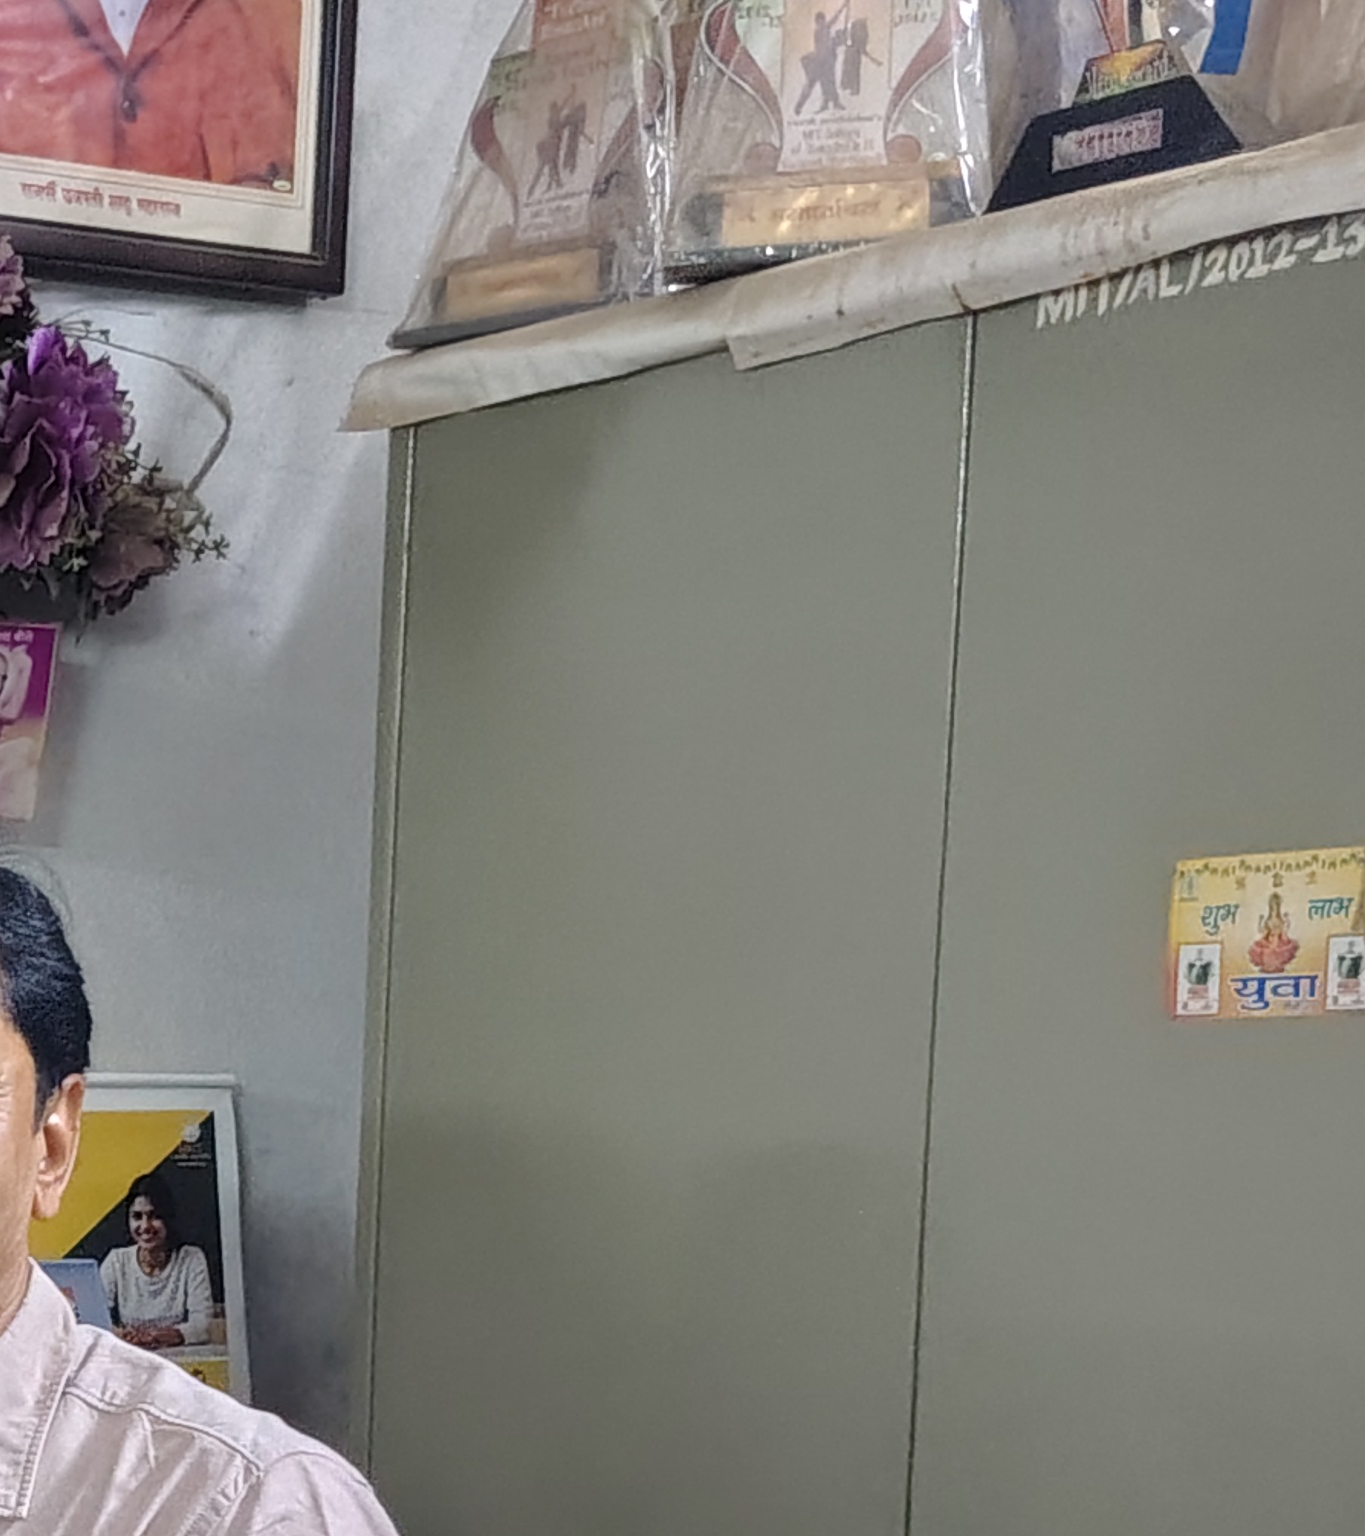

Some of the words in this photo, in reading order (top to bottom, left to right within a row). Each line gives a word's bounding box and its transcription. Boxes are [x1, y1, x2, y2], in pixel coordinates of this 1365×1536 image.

[1201, 903, 1240, 937] शुभ
[1308, 896, 1354, 921] लाभ
[1229, 974, 1319, 1010] युवा
